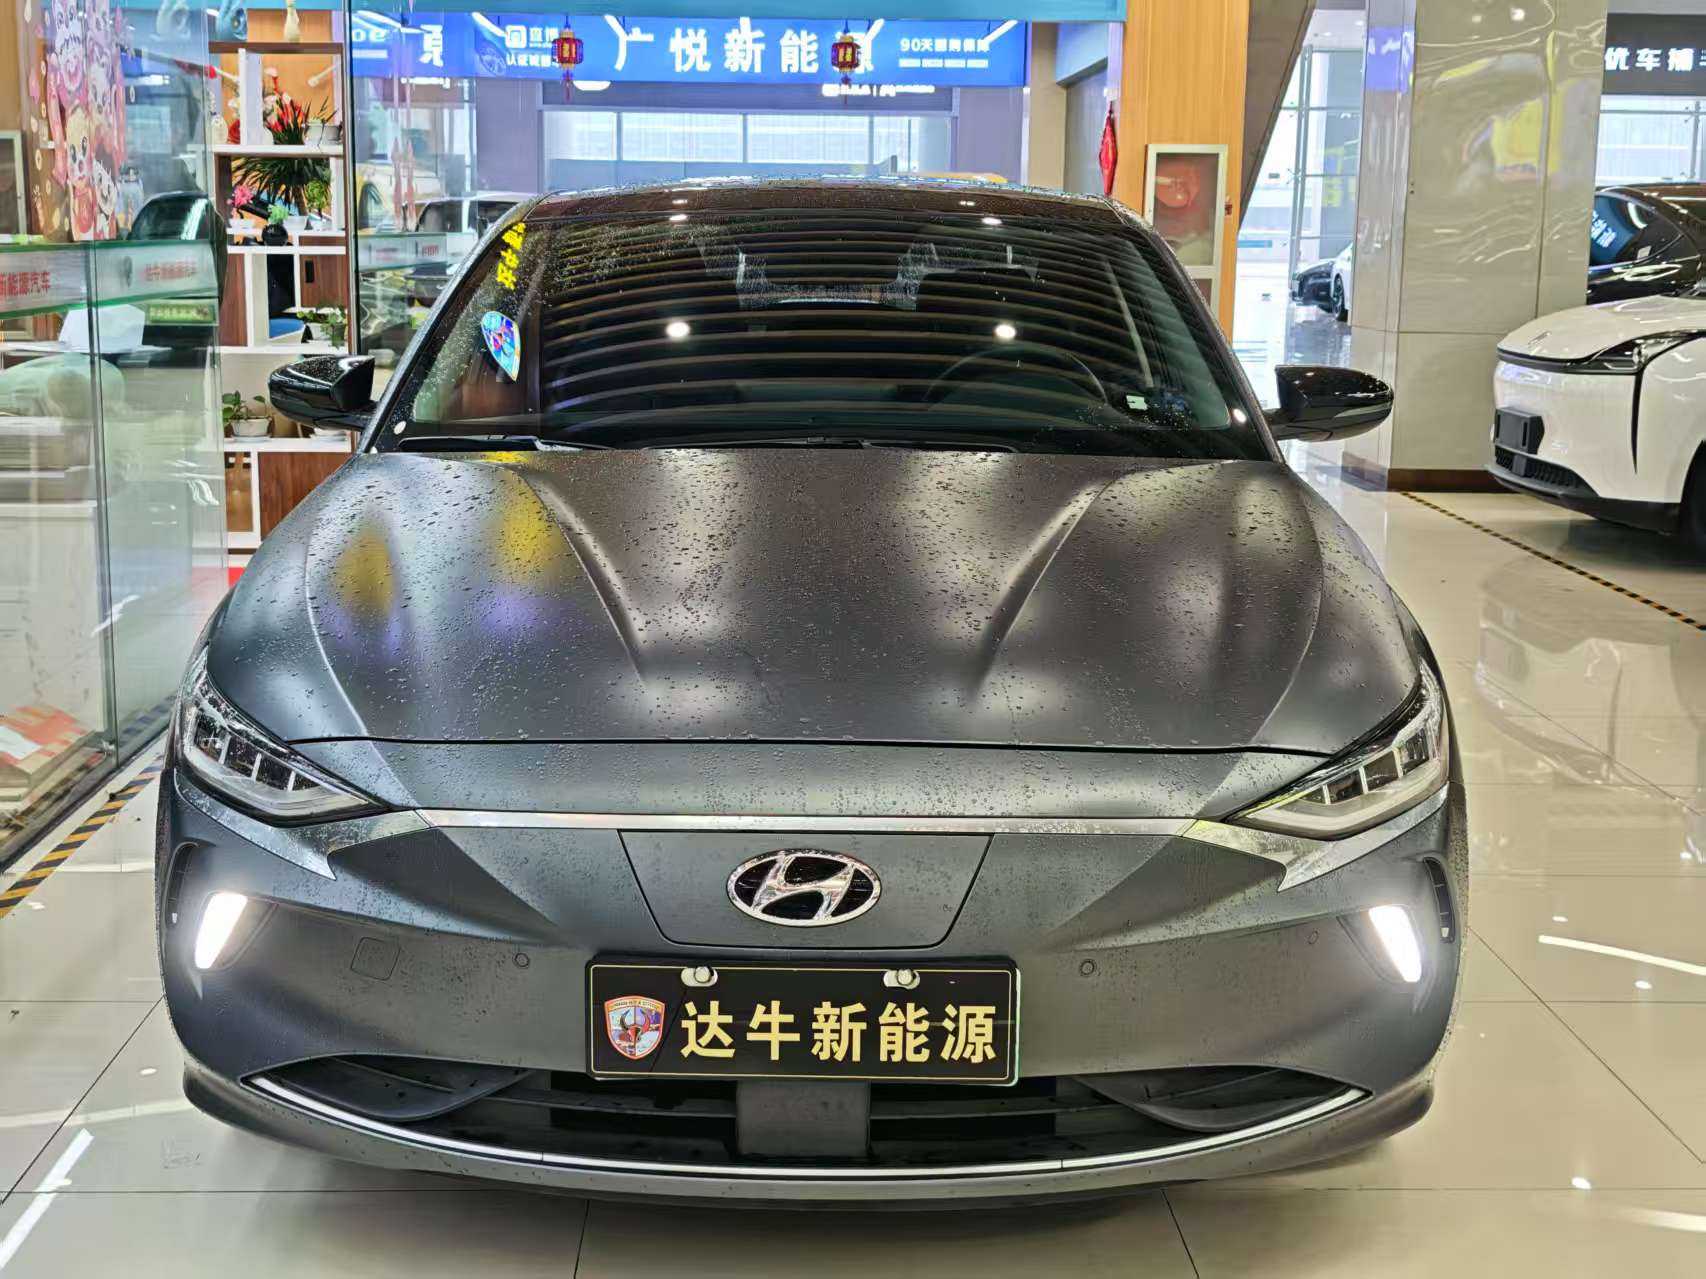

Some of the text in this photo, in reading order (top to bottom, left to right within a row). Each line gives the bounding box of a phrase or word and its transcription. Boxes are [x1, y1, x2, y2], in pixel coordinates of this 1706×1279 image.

[1604, 47, 1706, 71] 优车
[680, 1000, 998, 1064] 达牛新能源
